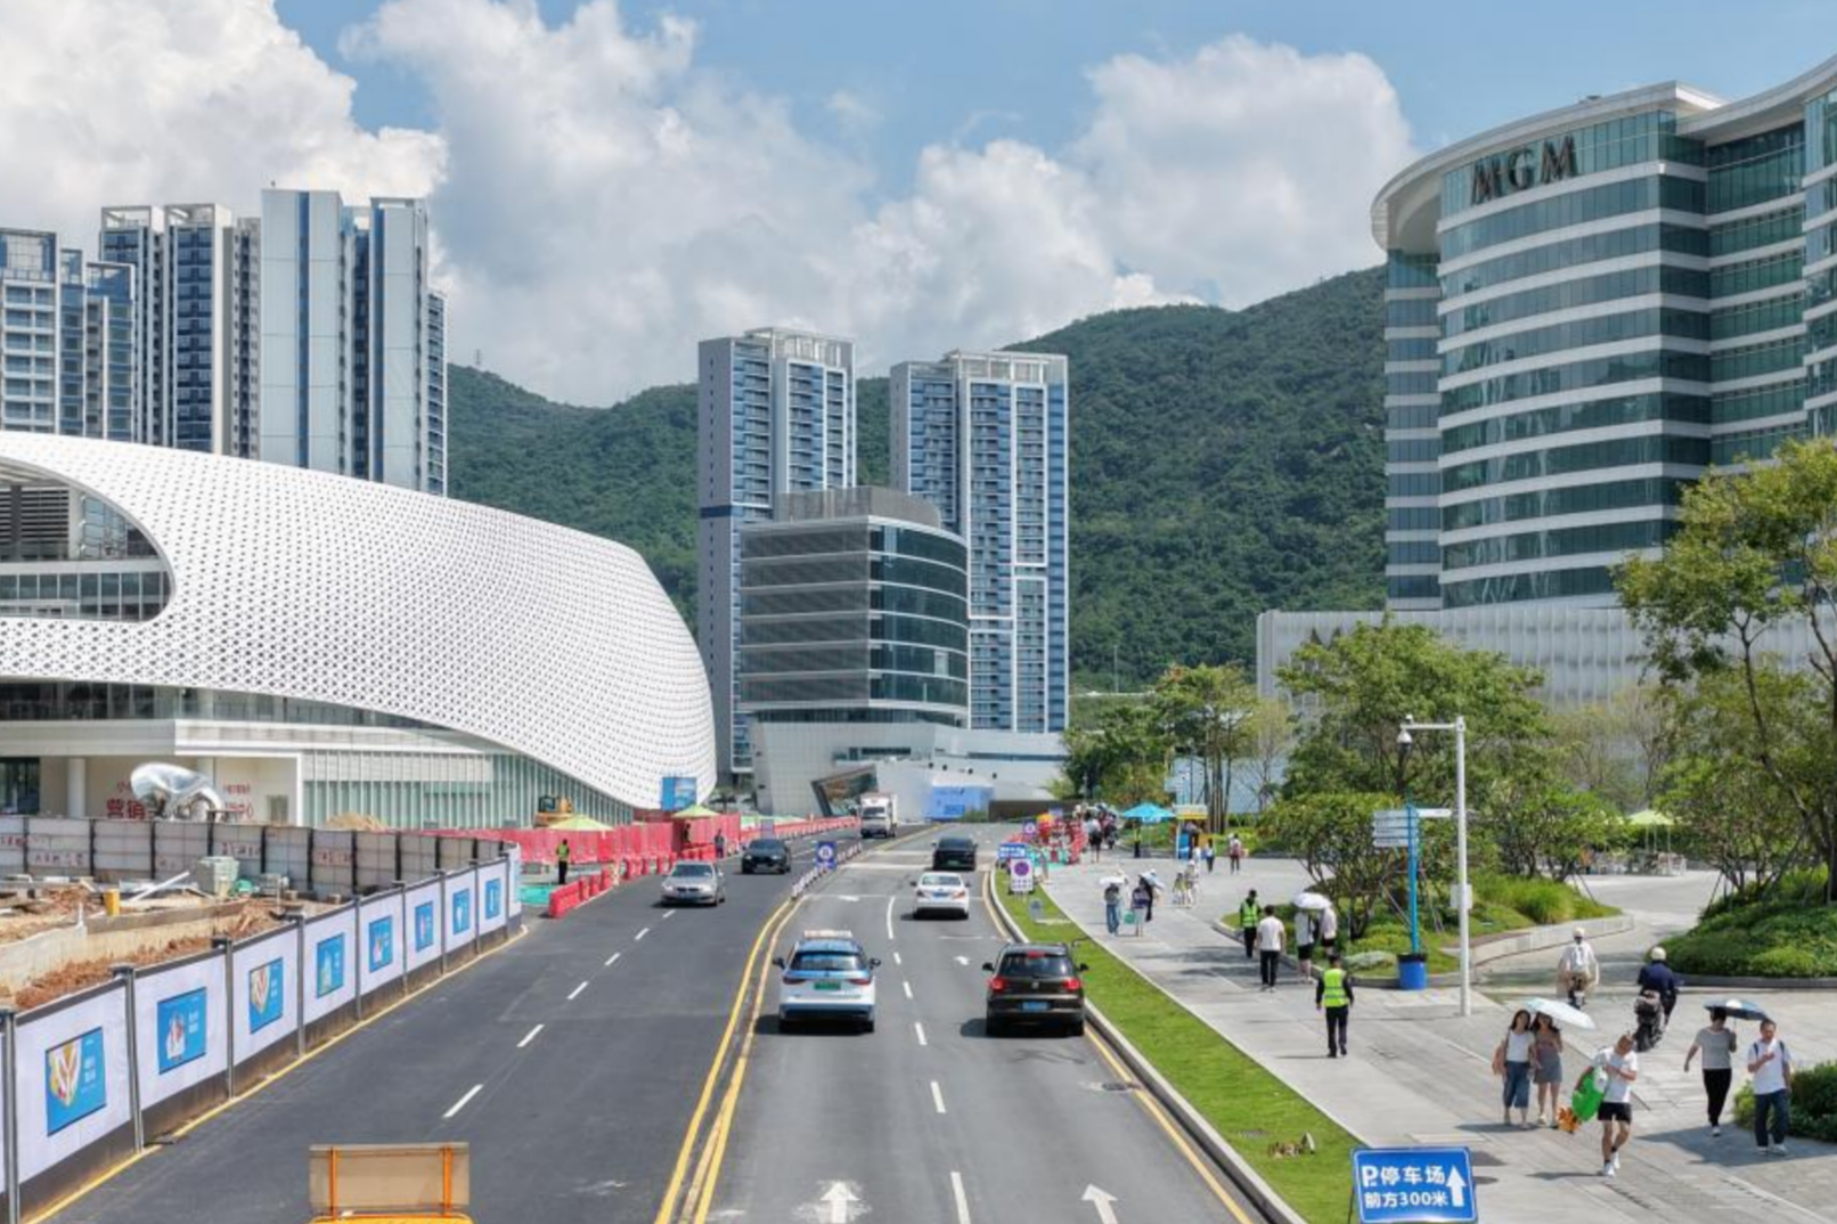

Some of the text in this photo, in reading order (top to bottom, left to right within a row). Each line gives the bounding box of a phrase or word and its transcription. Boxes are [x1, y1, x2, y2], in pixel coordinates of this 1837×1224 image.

[1471, 134, 1578, 207] MGM
[1364, 1190, 1448, 1209] 前方300米
